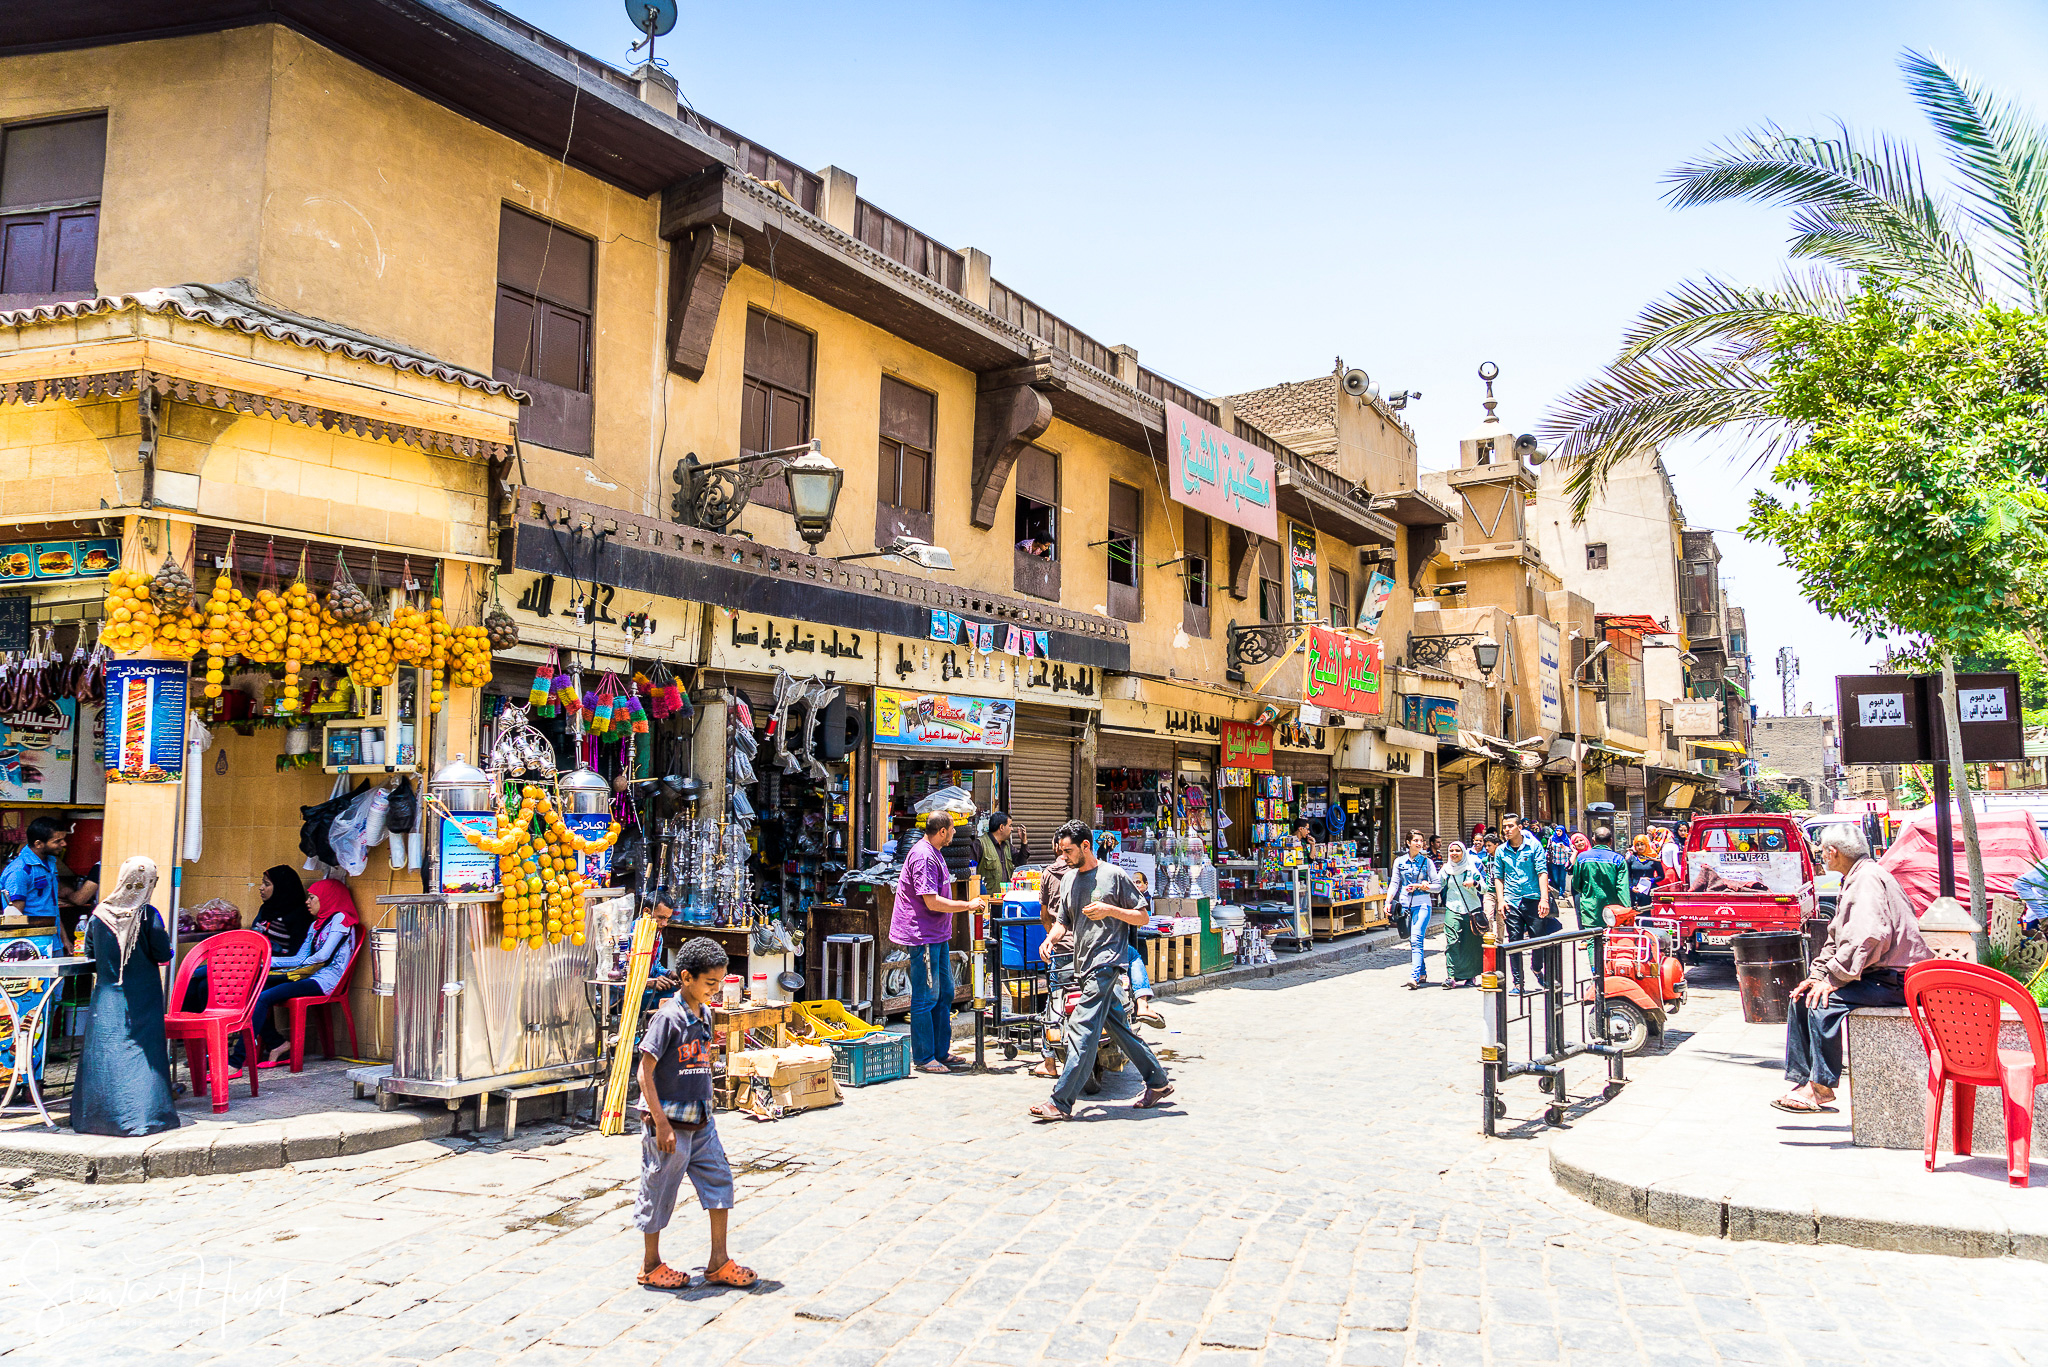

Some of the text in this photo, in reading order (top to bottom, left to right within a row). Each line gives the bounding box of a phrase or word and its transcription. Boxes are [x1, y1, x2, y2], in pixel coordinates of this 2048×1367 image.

[1179, 419, 1270, 512] مكتبة الشيخ
[1291, 545, 1317, 567] الشيخ
[761, 620, 783, 657] غيار
[785, 625, 815, 653] قطع
[1308, 637, 1380, 704] مكتبة الشيخ
[1868, 698, 1895, 709] هل اليوم
[1969, 693, 1997, 703] هل اليوم
[936, 704, 967, 724] مكتبة
[1888, 708, 1902, 723] صليت
[1989, 703, 2004, 718] صليت
[962, 727, 982, 743] على
[1226, 726, 1247, 762] الشيخ
[1247, 729, 1271, 762] مكتبة
